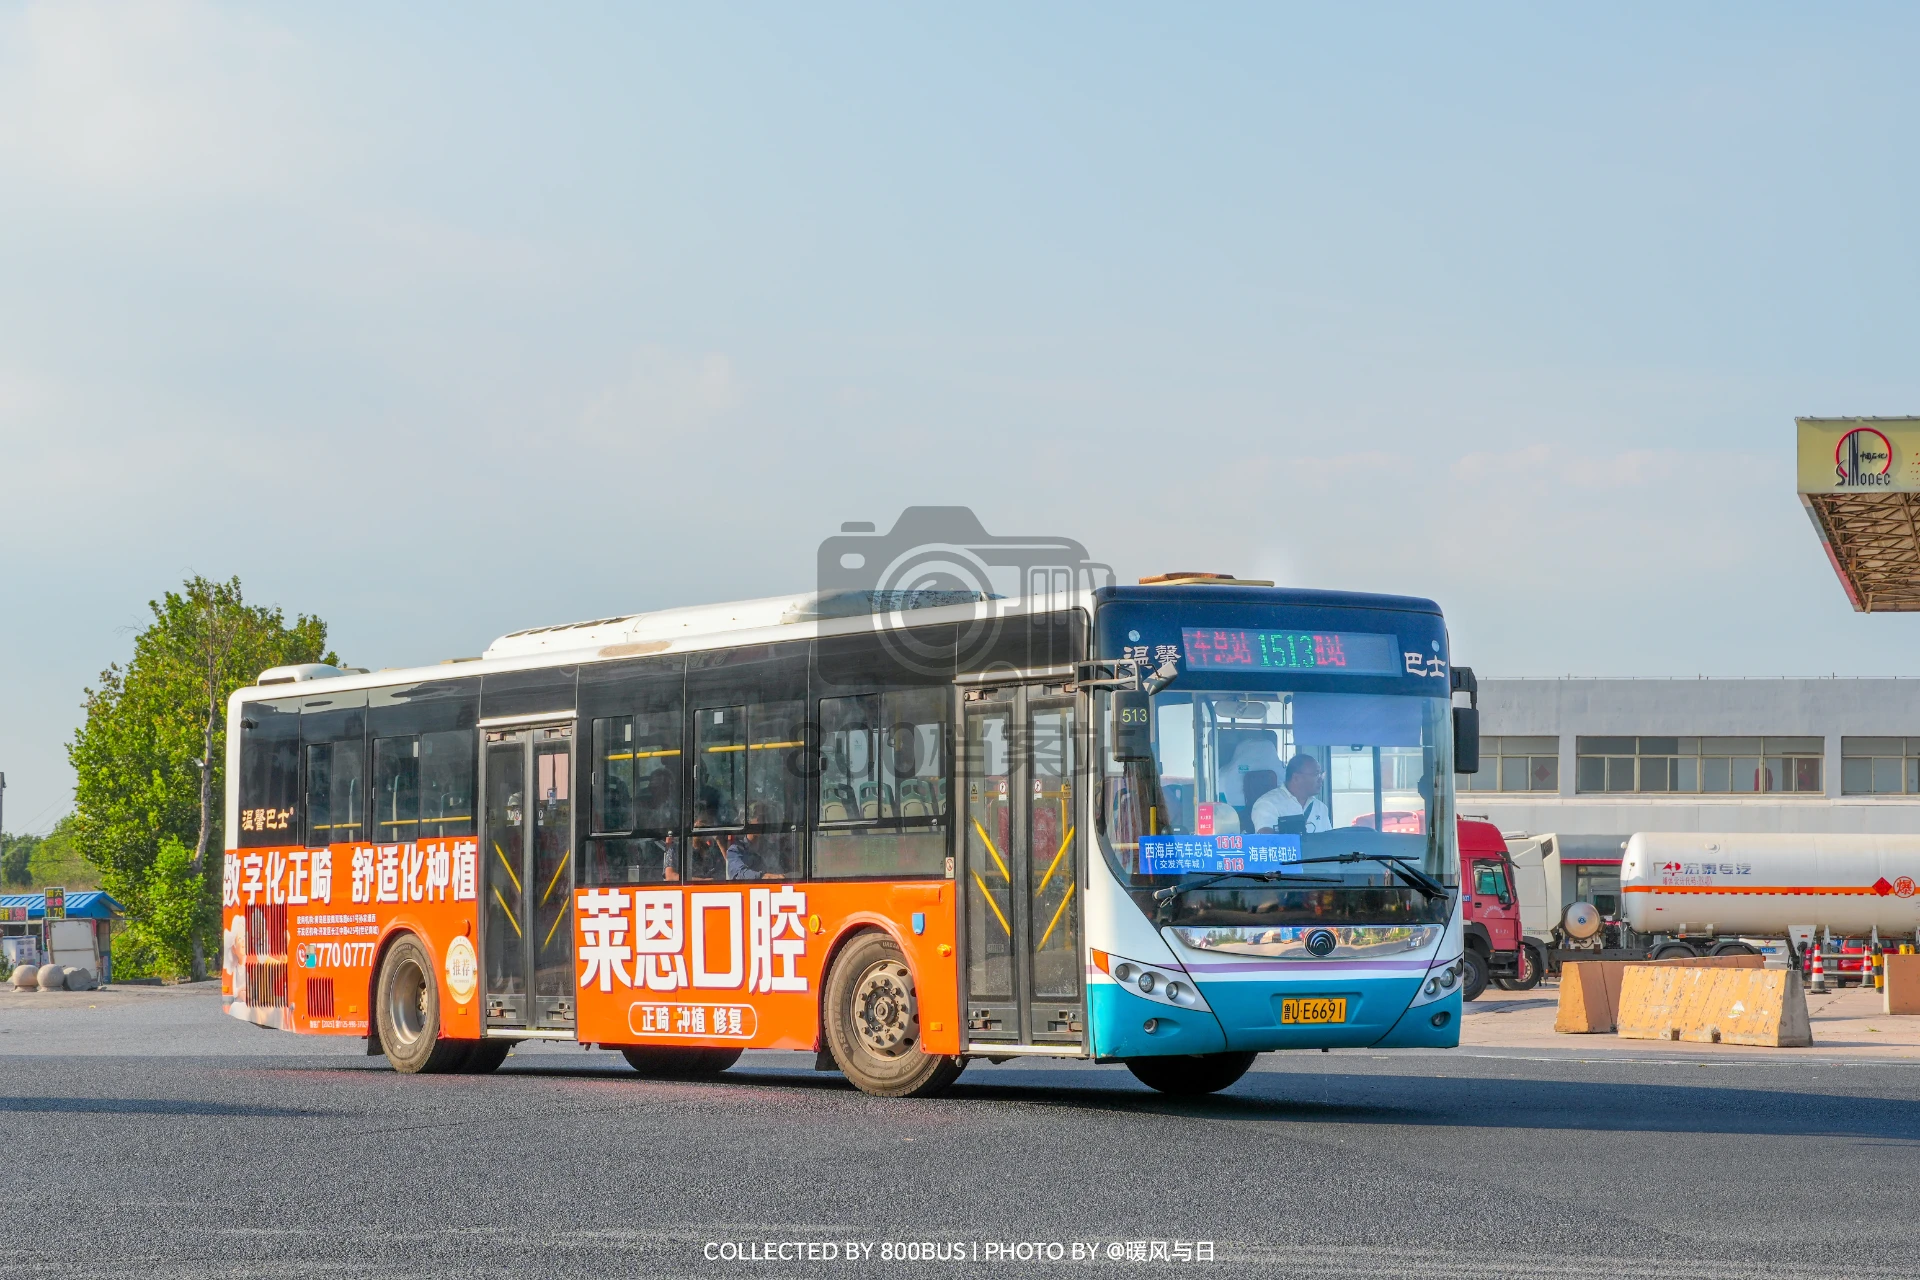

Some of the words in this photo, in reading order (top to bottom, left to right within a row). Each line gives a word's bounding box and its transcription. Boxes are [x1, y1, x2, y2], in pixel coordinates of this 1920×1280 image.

[1257, 634, 1315, 668] 1513
[1404, 652, 1446, 677] 巴士
[1122, 708, 1148, 723] 513
[1145, 842, 1213, 859] 西海岸汽车总站
[1215, 836, 1243, 849] 1513
[1249, 846, 1297, 862] 海青枢纽站
[222, 848, 332, 908] 数字化正畸
[351, 841, 477, 904] 舒适化种植
[577, 885, 808, 993] 莱恩口腔
[308, 942, 341, 967] 770
[343, 942, 375, 967] 0777
[642, 1006, 669, 1031] 正畸
[677, 1007, 705, 1033] 种植
[713, 1007, 743, 1034] 修复
